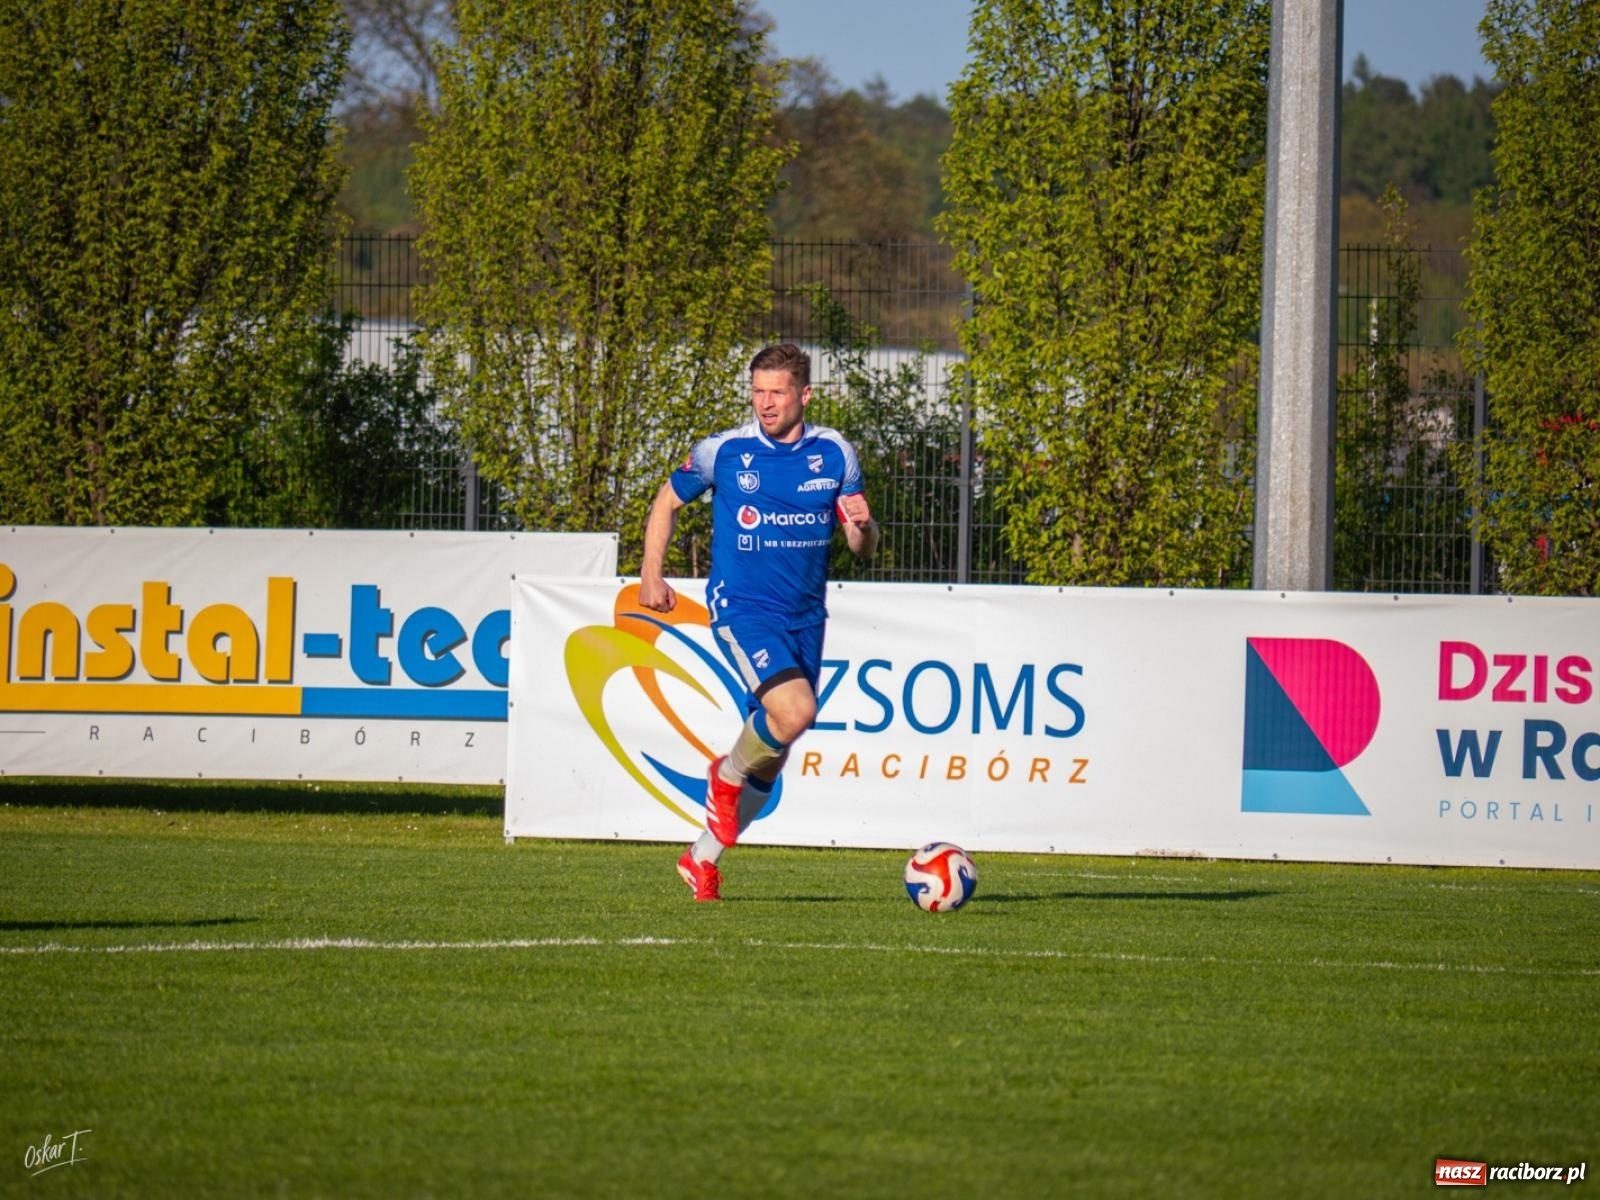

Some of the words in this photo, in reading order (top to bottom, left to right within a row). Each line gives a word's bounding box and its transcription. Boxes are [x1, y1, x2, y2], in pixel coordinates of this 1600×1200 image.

[762, 511, 816, 526] Marco
[764, 540, 778, 548] MB
[811, 658, 1086, 738] ZSOMS
[89, 724, 475, 749] RACIBÓRZ
[1436, 728, 1503, 778] w
[801, 750, 1089, 784] RACIBÓRZ
[1439, 800, 1564, 822] PORTAL
